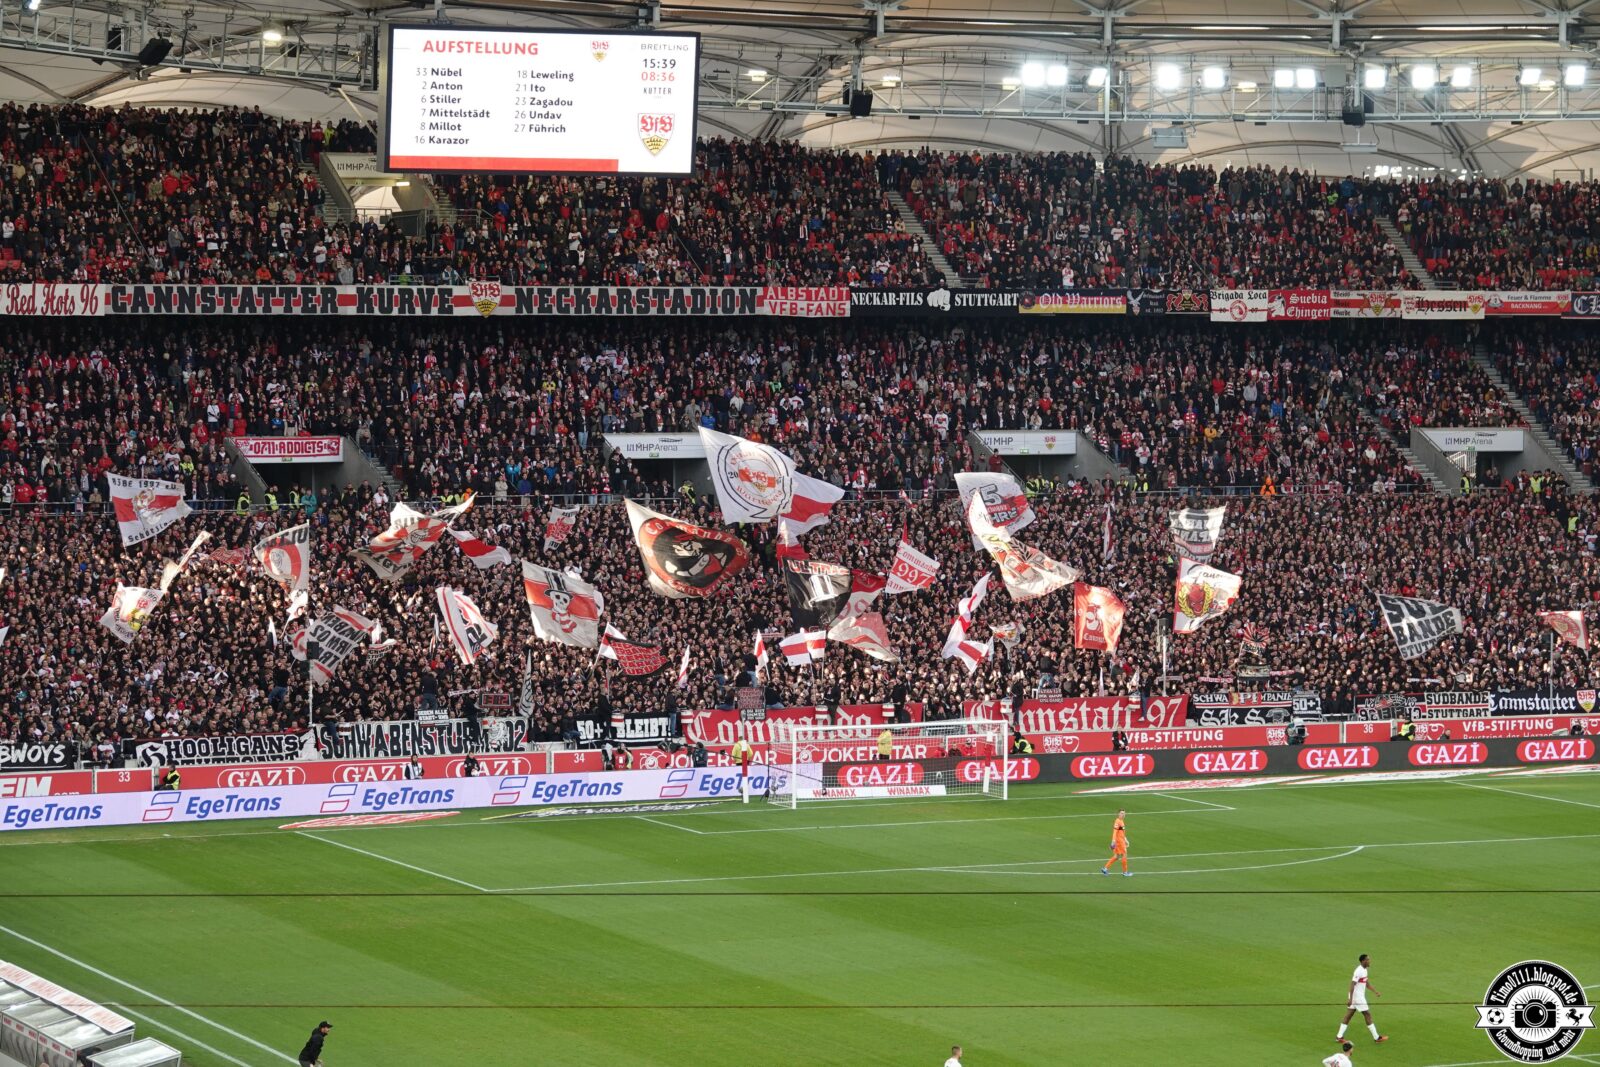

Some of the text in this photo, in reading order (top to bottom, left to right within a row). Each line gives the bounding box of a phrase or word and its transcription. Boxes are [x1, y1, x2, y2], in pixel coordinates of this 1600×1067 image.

[423, 40, 539, 56] AUFSTELLUNG
[640, 43, 689, 52] BREITLING
[643, 58, 677, 69] 15:39
[415, 67, 463, 77] 33 Nübel
[516, 70, 574, 82] 18 Leweling
[641, 71, 675, 81] 08:36
[421, 81, 463, 91] 2 Anton
[515, 83, 546, 93] 21 Ito
[420, 95, 461, 104] 6 Stiller
[515, 97, 573, 109] 23 Zagadou
[420, 108, 490, 119] 7 Mittelstädt
[514, 110, 562, 120] 26 Undav
[419, 121, 462, 132] 8 Millot
[513, 122, 566, 134] 27 Führich
[414, 135, 469, 146] 16 Karazor
[6, 284, 99, 315] Red Hots 96
[766, 287, 849, 300] ALBSTADT
[851, 291, 924, 307] NECKAR-FILS
[954, 292, 1020, 307] STUTTGART
[1290, 293, 1327, 305] Suebia
[111, 286, 454, 314] CANNSTATTER KURVE
[514, 287, 759, 315] NECKARSTADION
[1065, 292, 1123, 309] Warriors
[1414, 296, 1468, 315] Hessen
[768, 301, 847, 317] VFB-FANS
[278, 440, 324, 454] ADDICTS
[992, 436, 1014, 446] MHP
[636, 444, 678, 452] MHP Arena
[891, 557, 932, 588] 1997
[1146, 698, 1184, 729] 97
[1428, 708, 1490, 718] STUTTGART
[683, 710, 872, 744] Commando
[1363, 724, 1374, 734] 36
[1462, 718, 1554, 732] VfB-STIFTUNG
[1126, 730, 1224, 744] VfB-STIFTUNG
[163, 734, 300, 758] HOOLIGANS
[574, 753, 586, 763] 34
[118, 772, 131, 782] 33
[699, 771, 788, 796] EgeTrans
[532, 778, 623, 802] EgeTrans
[888, 786, 931, 796] WINAMAX
[362, 786, 455, 811] EgeTrans
[186, 794, 282, 819] EgeTrans
[4, 804, 103, 828] EgeTrans
